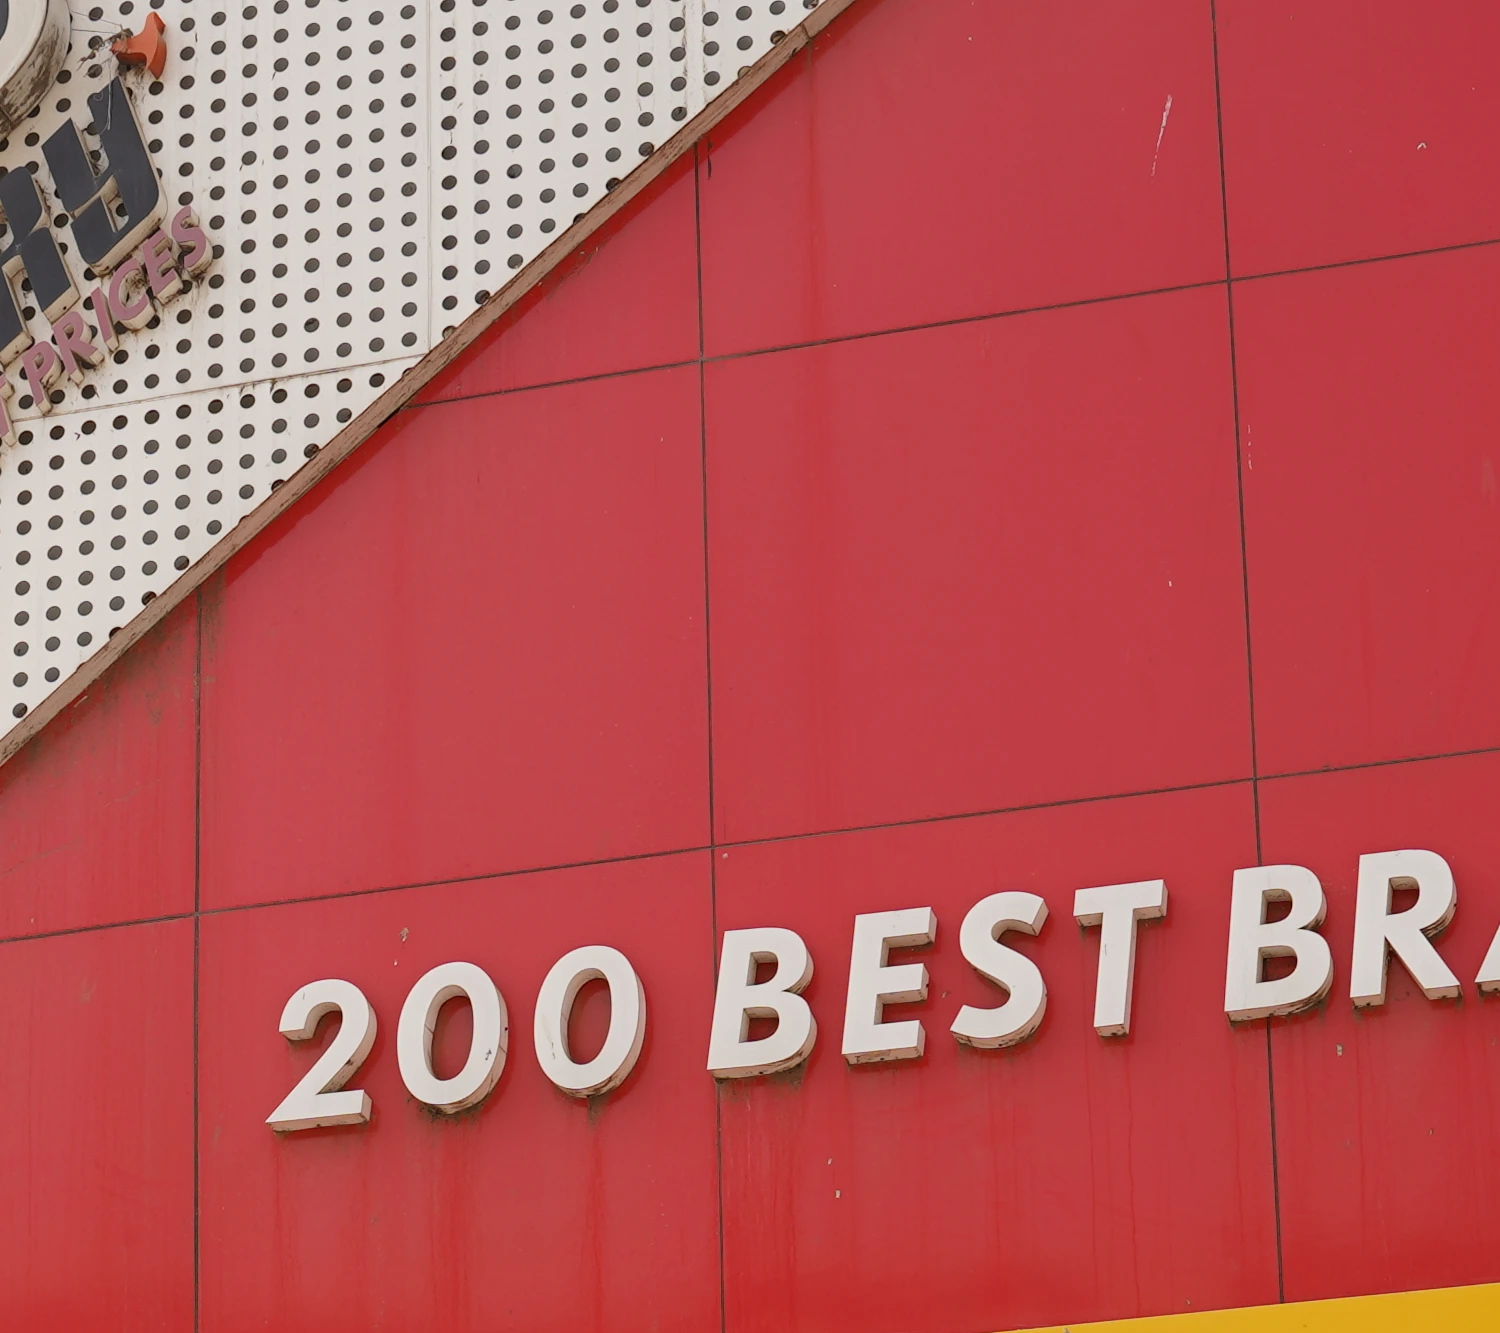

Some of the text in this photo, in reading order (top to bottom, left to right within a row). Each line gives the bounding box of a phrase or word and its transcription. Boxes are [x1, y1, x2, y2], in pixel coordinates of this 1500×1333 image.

[19, 205, 212, 414] PRICES
[266, 943, 646, 1134] 200
[706, 878, 1169, 1079] BEST
